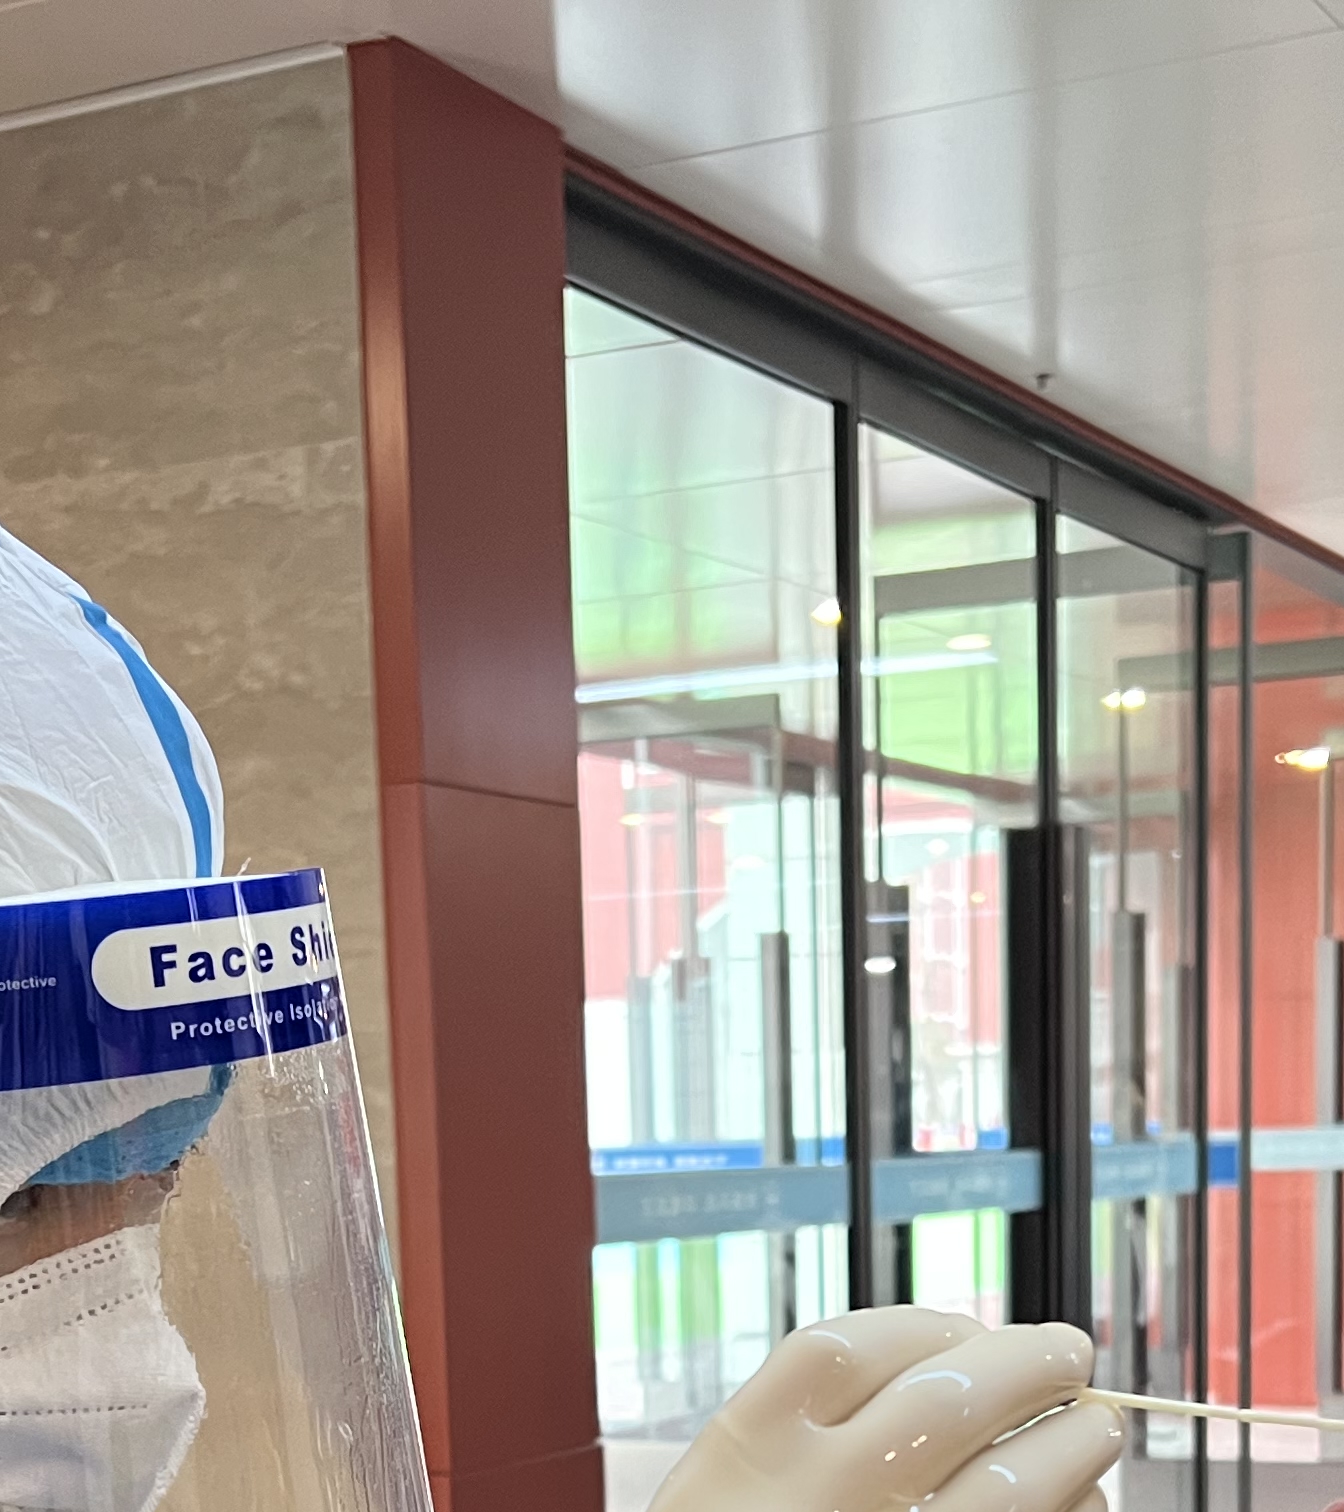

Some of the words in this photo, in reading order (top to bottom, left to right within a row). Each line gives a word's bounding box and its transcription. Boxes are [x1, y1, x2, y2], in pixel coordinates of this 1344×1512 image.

[149, 941, 274, 988] Face
[290, 920, 335, 967] Shi
[170, 1008, 284, 1040] Protective
